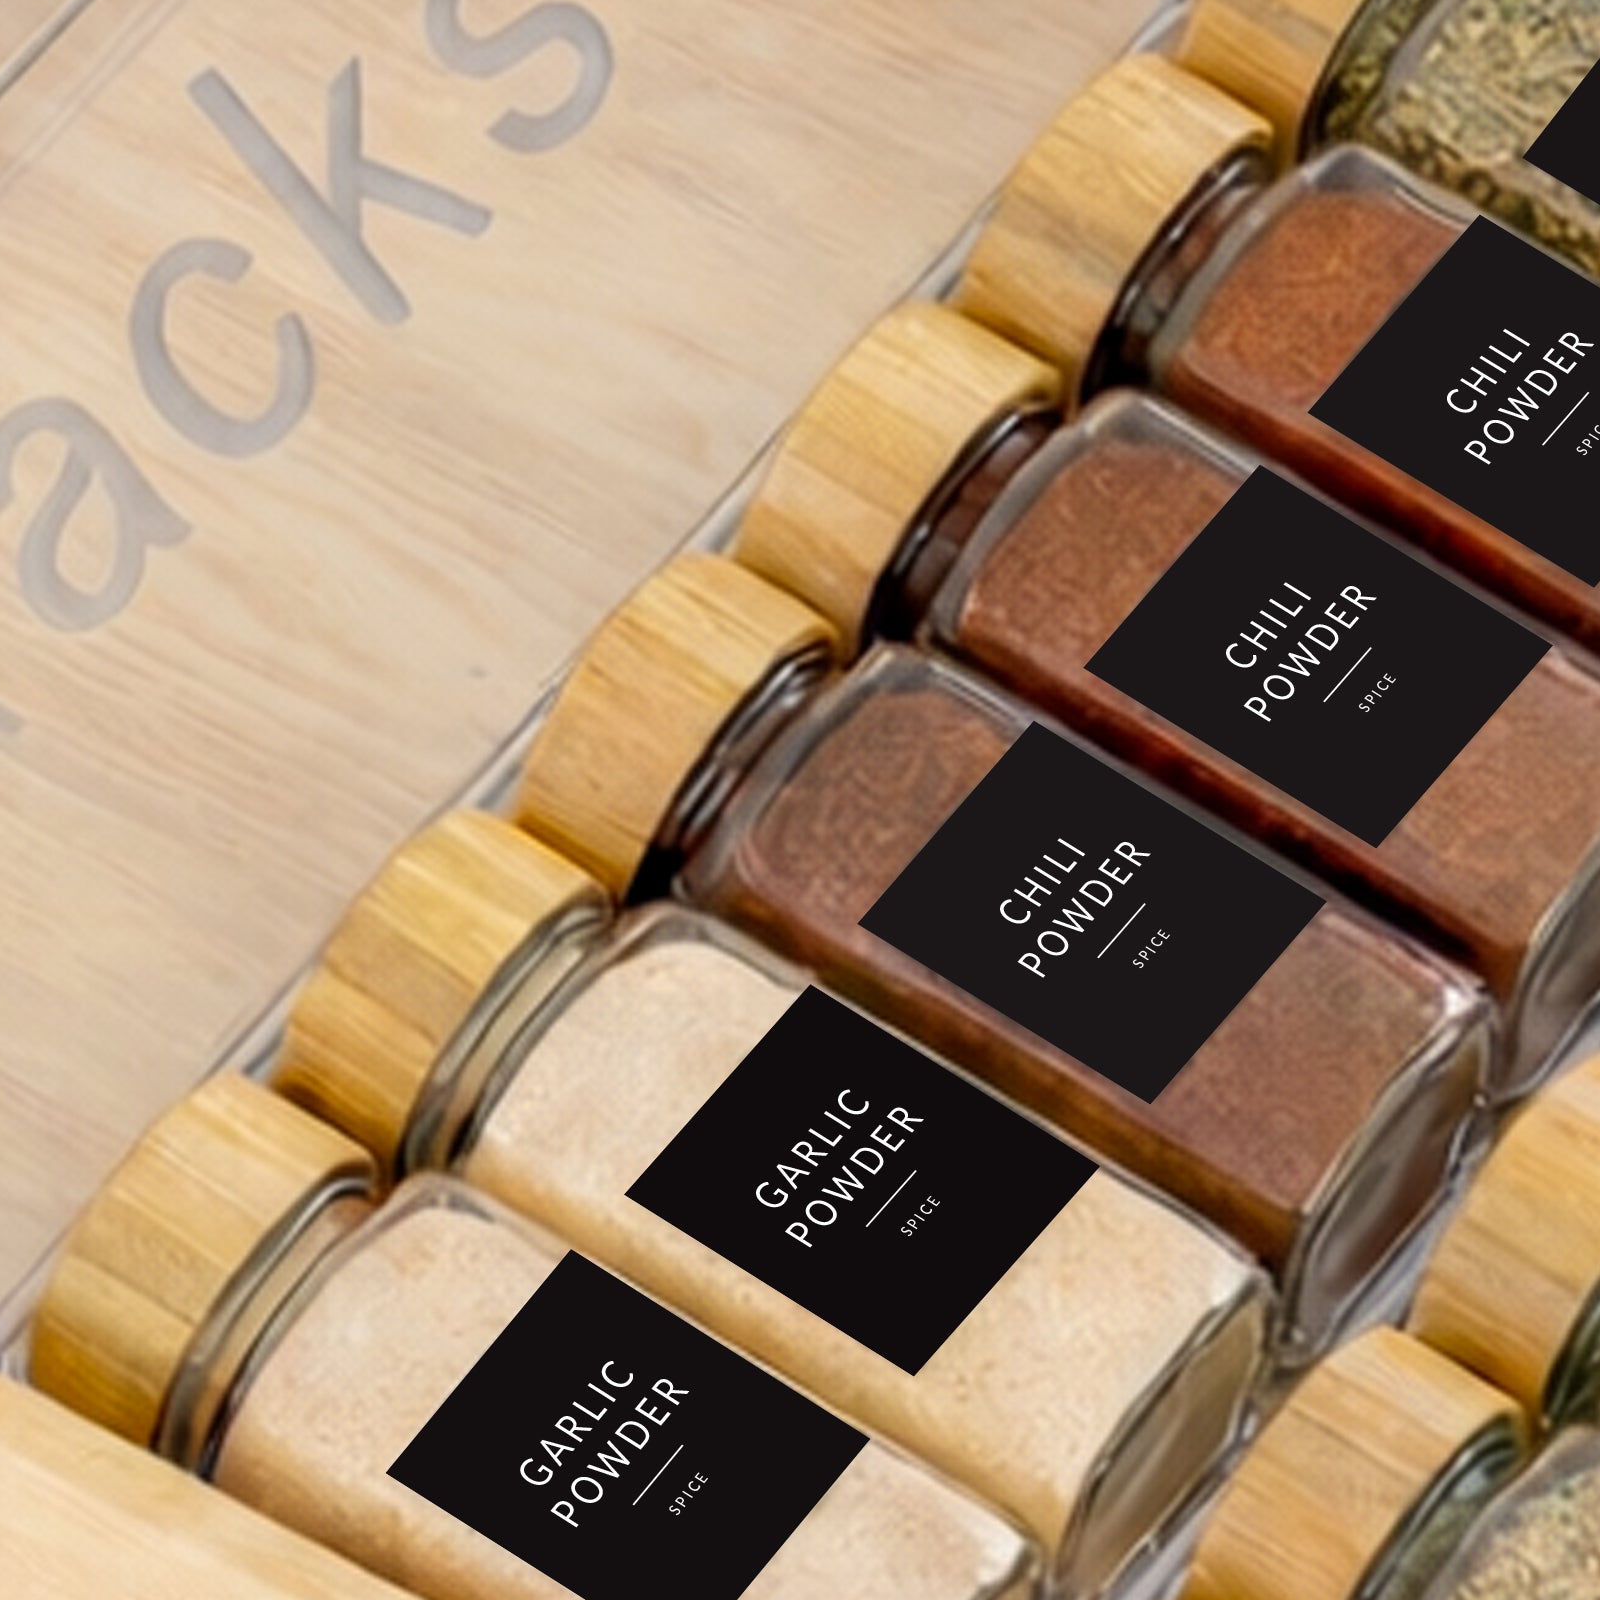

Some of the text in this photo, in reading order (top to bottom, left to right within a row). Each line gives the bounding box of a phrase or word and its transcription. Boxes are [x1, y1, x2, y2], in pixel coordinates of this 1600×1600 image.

[1447, 329, 1530, 413] CHILI
[1464, 332, 1594, 465] POWDER
[1226, 582, 1311, 668] CHILI
[1243, 586, 1377, 722] POWDER
[1359, 673, 1396, 712] SPICE
[1000, 838, 1085, 924] CHILI
[1017, 842, 1151, 978] POWDER
[1133, 929, 1170, 968] SPICE
[756, 1089, 869, 1207] GARLIC
[785, 1107, 924, 1247] POWDER
[901, 1196, 940, 1236] SPICE
[520, 1361, 633, 1485] GARLIC
[550, 1379, 689, 1527] POWDER
[669, 1472, 708, 1515] SPICE
